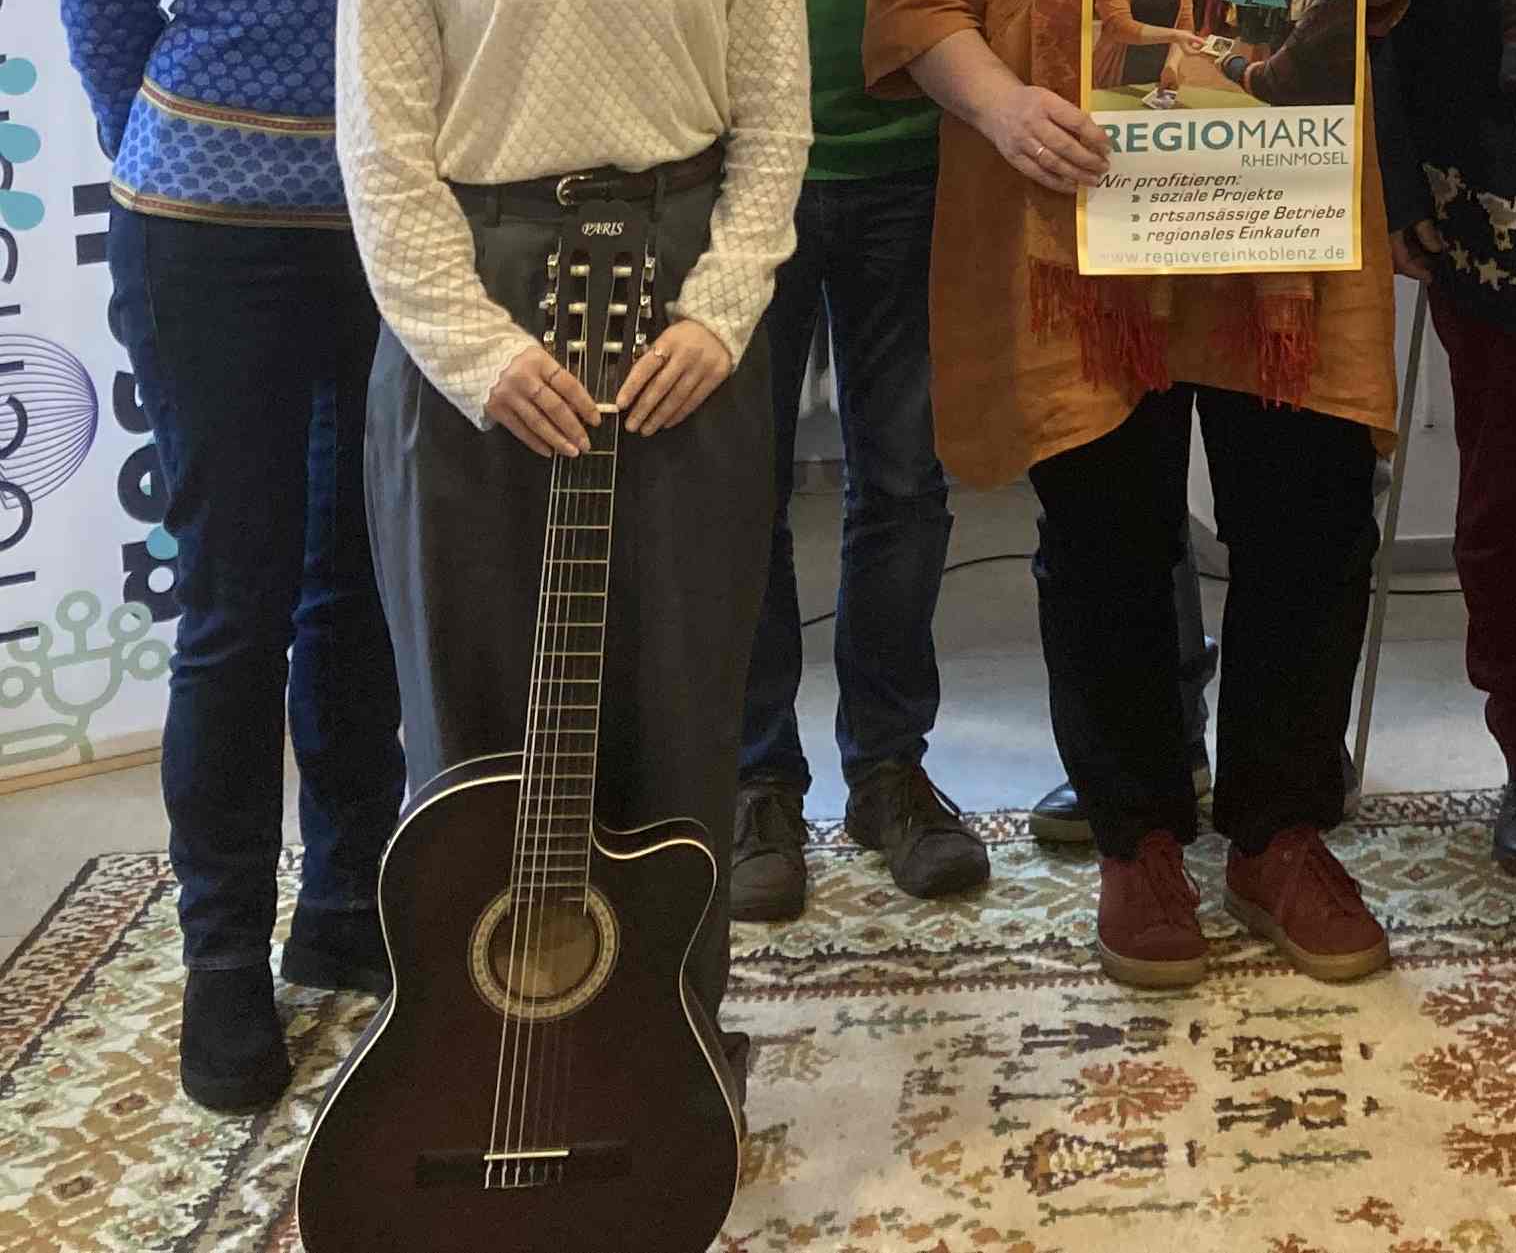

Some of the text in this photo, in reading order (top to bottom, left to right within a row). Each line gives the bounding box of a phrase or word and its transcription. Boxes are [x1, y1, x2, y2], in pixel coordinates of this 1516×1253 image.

[1099, 117, 1347, 153] REGIOMARK
[1241, 151, 1349, 167] RHEINMOSEL
[1133, 172, 1243, 192] profitieren:
[1149, 187, 1285, 205] soziale Projekte
[1148, 205, 1347, 225] ortsansässige Betriebe
[1146, 225, 1321, 246] regionales Einkaufen
